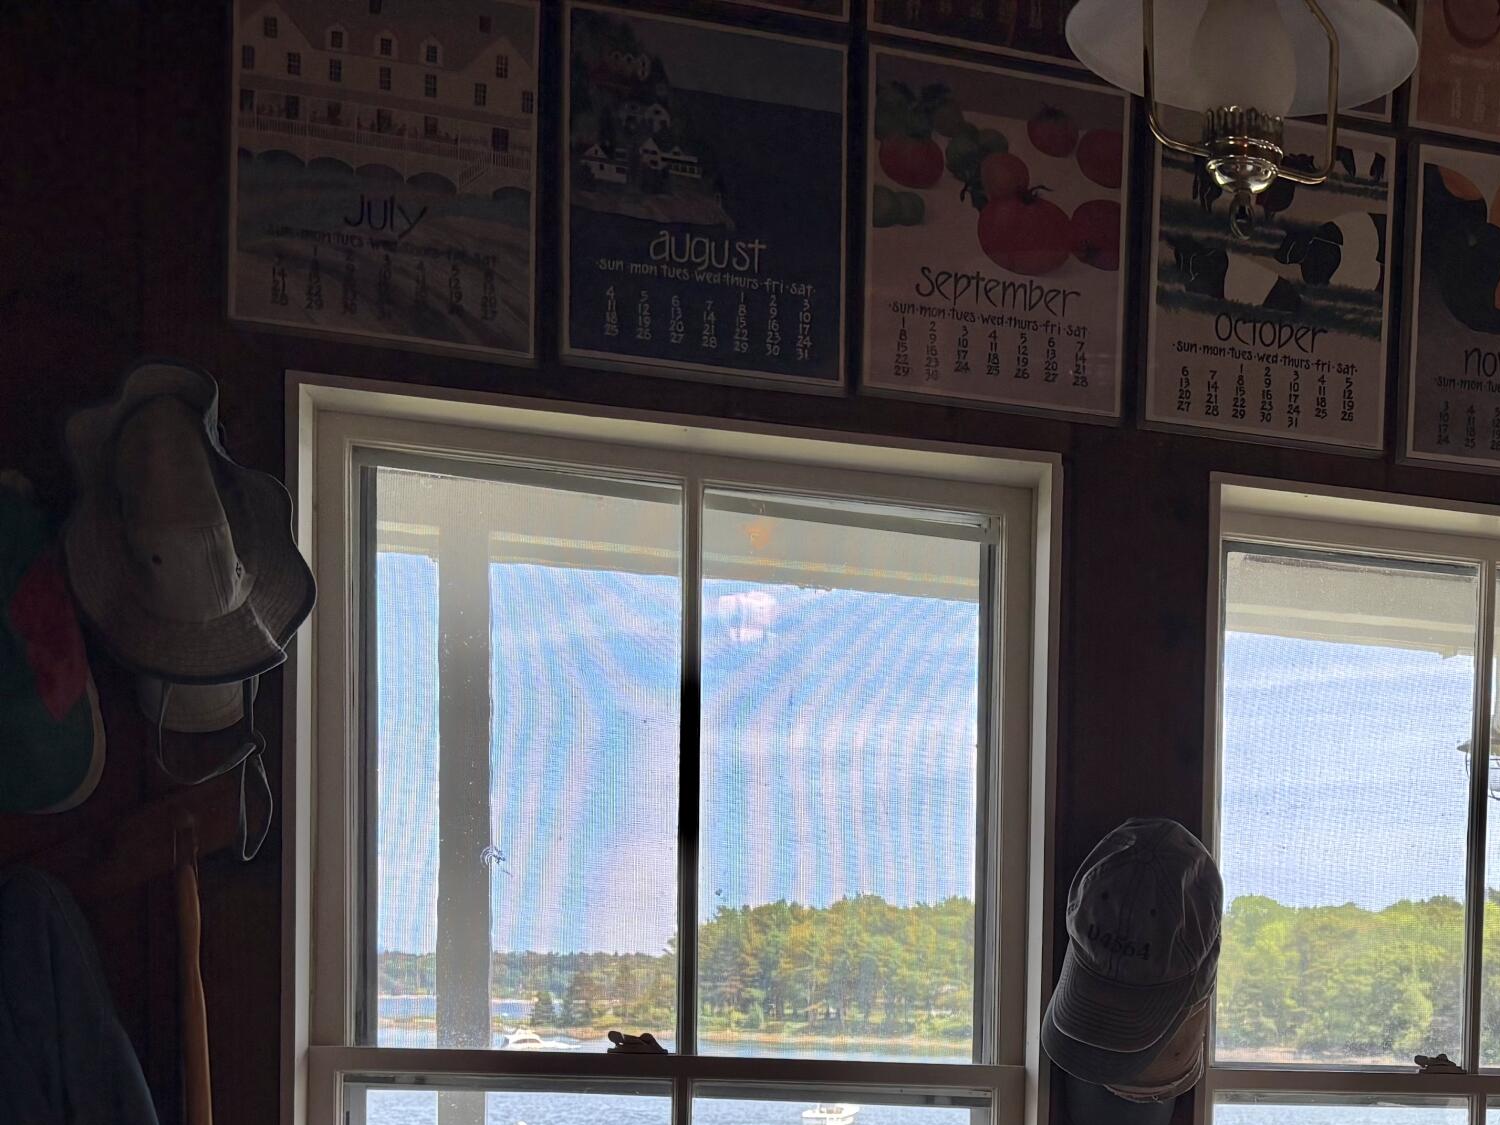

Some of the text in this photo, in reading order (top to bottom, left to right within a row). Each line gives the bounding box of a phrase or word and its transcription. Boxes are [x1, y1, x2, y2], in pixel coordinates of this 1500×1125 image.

[649, 229, 767, 273] august
[606, 285, 811, 324] 4 5 6 7 8 9 10
[770, 295, 777, 306] 2
[803, 300, 810, 311] 3
[900, 329, 1086, 363] 8 9 10 11 12 13 14
[929, 322, 936, 332] 2
[962, 326, 968, 336] 3
[988, 330, 997, 340] 4
[1021, 334, 1027, 344] 5
[1048, 337, 1055, 347] 6
[1077, 342, 1084, 352] 7
[895, 366, 909, 376] 29
[897, 342, 908, 352] 15
[958, 350, 968, 360] 17
[988, 353, 999, 364] 18
[1017, 358, 1028, 367] 19
[1045, 361, 1058, 371] 20
[1075, 364, 1086, 374] 21
[955, 361, 969, 372] 24
[1015, 369, 1029, 378] 26
[1044, 372, 1057, 383] 27
[1182, 367, 1353, 399] 6 7 8 9 10 11 12
[1265, 367, 1271, 377] 2
[1293, 371, 1298, 381] 3
[1318, 375, 1325, 385] 4
[1346, 378, 1352, 388] 5
[1179, 390, 1354, 421] 20 21 22 23 24 25 26
[1180, 379, 1354, 410] 13 14 15 16 17 18 19
[1177, 401, 1297, 427] 27 28 29 30 31
